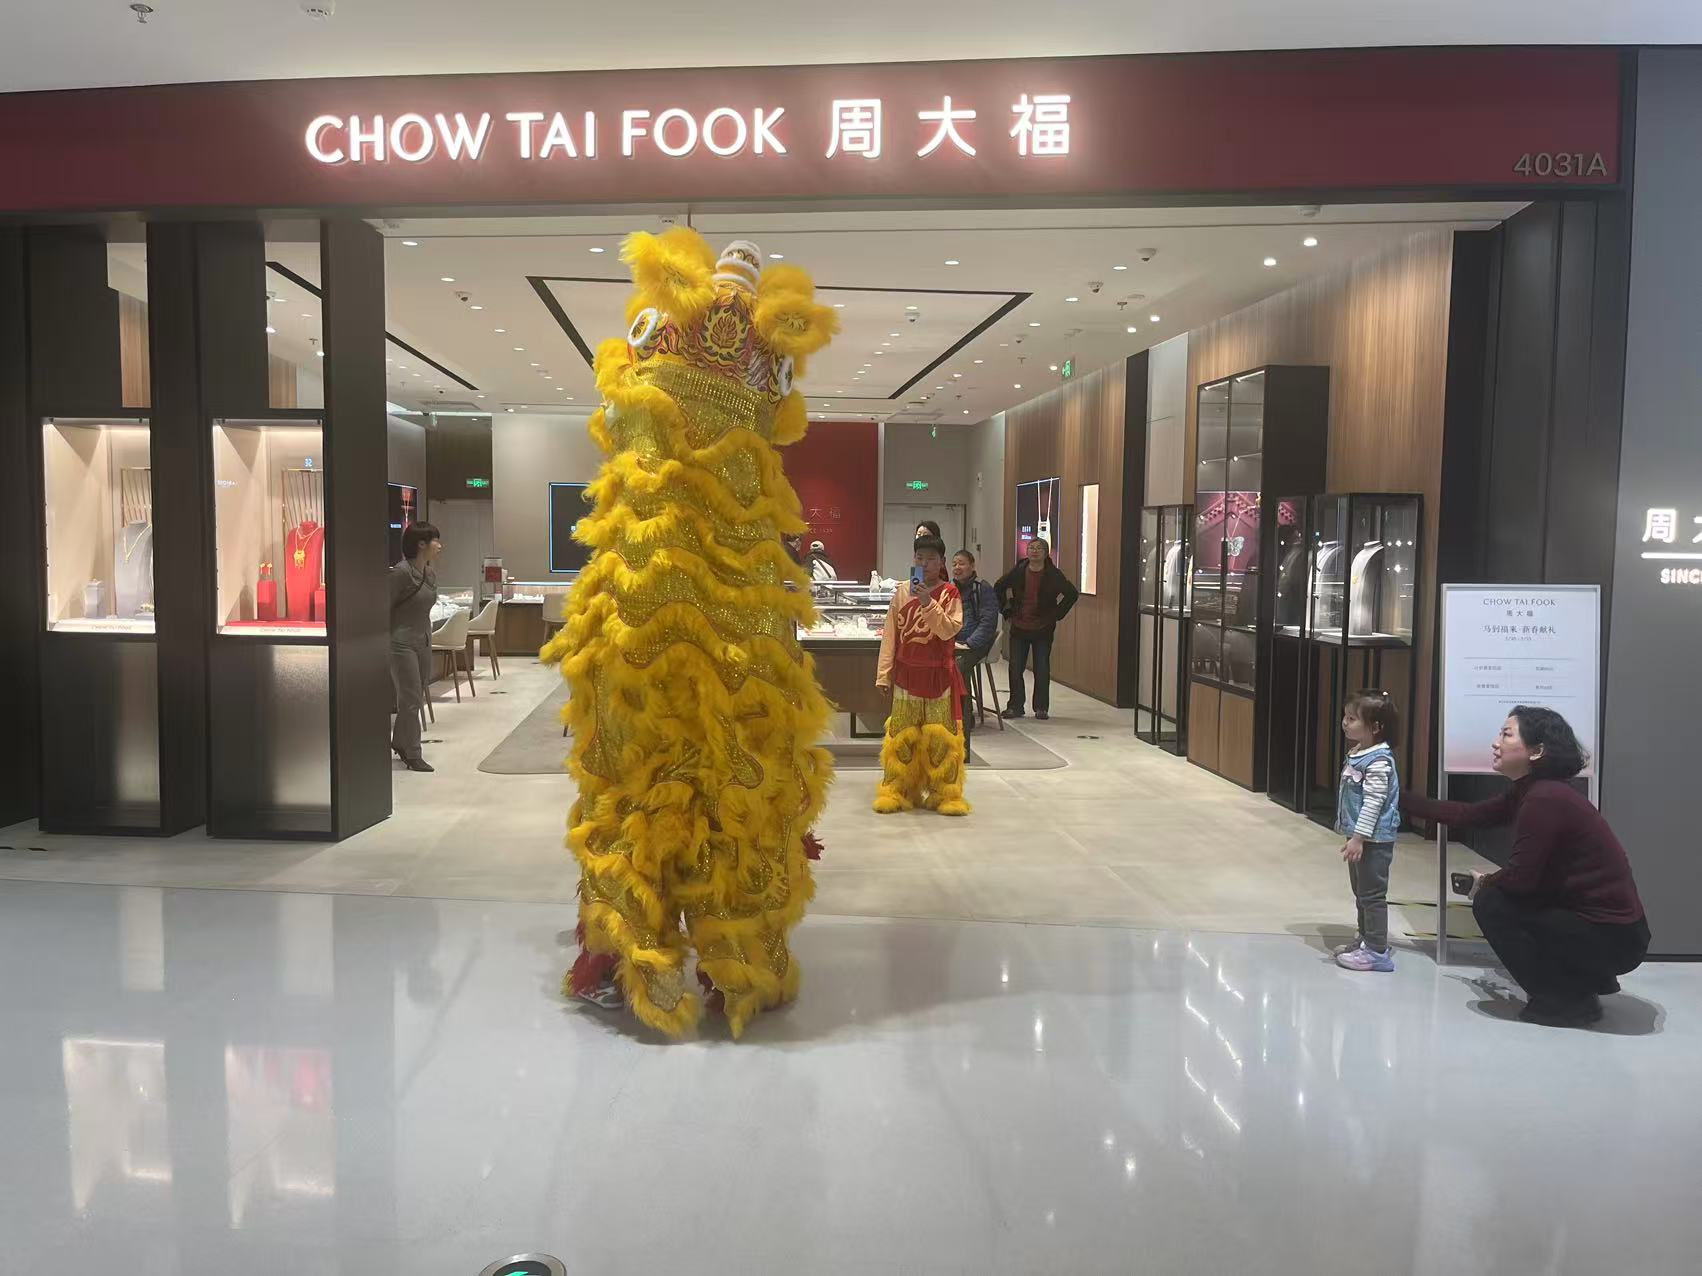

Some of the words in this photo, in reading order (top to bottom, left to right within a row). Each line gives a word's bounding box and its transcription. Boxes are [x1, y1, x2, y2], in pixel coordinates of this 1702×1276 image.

[304, 113, 491, 163] CHOW
[506, 111, 596, 159] TAI
[621, 107, 788, 157] FOOK
[825, 93, 1071, 159] 周大福
[1513, 152, 1608, 177] 4031A
[1641, 507, 1702, 544] 周
[1660, 568, 1702, 584] SINC
